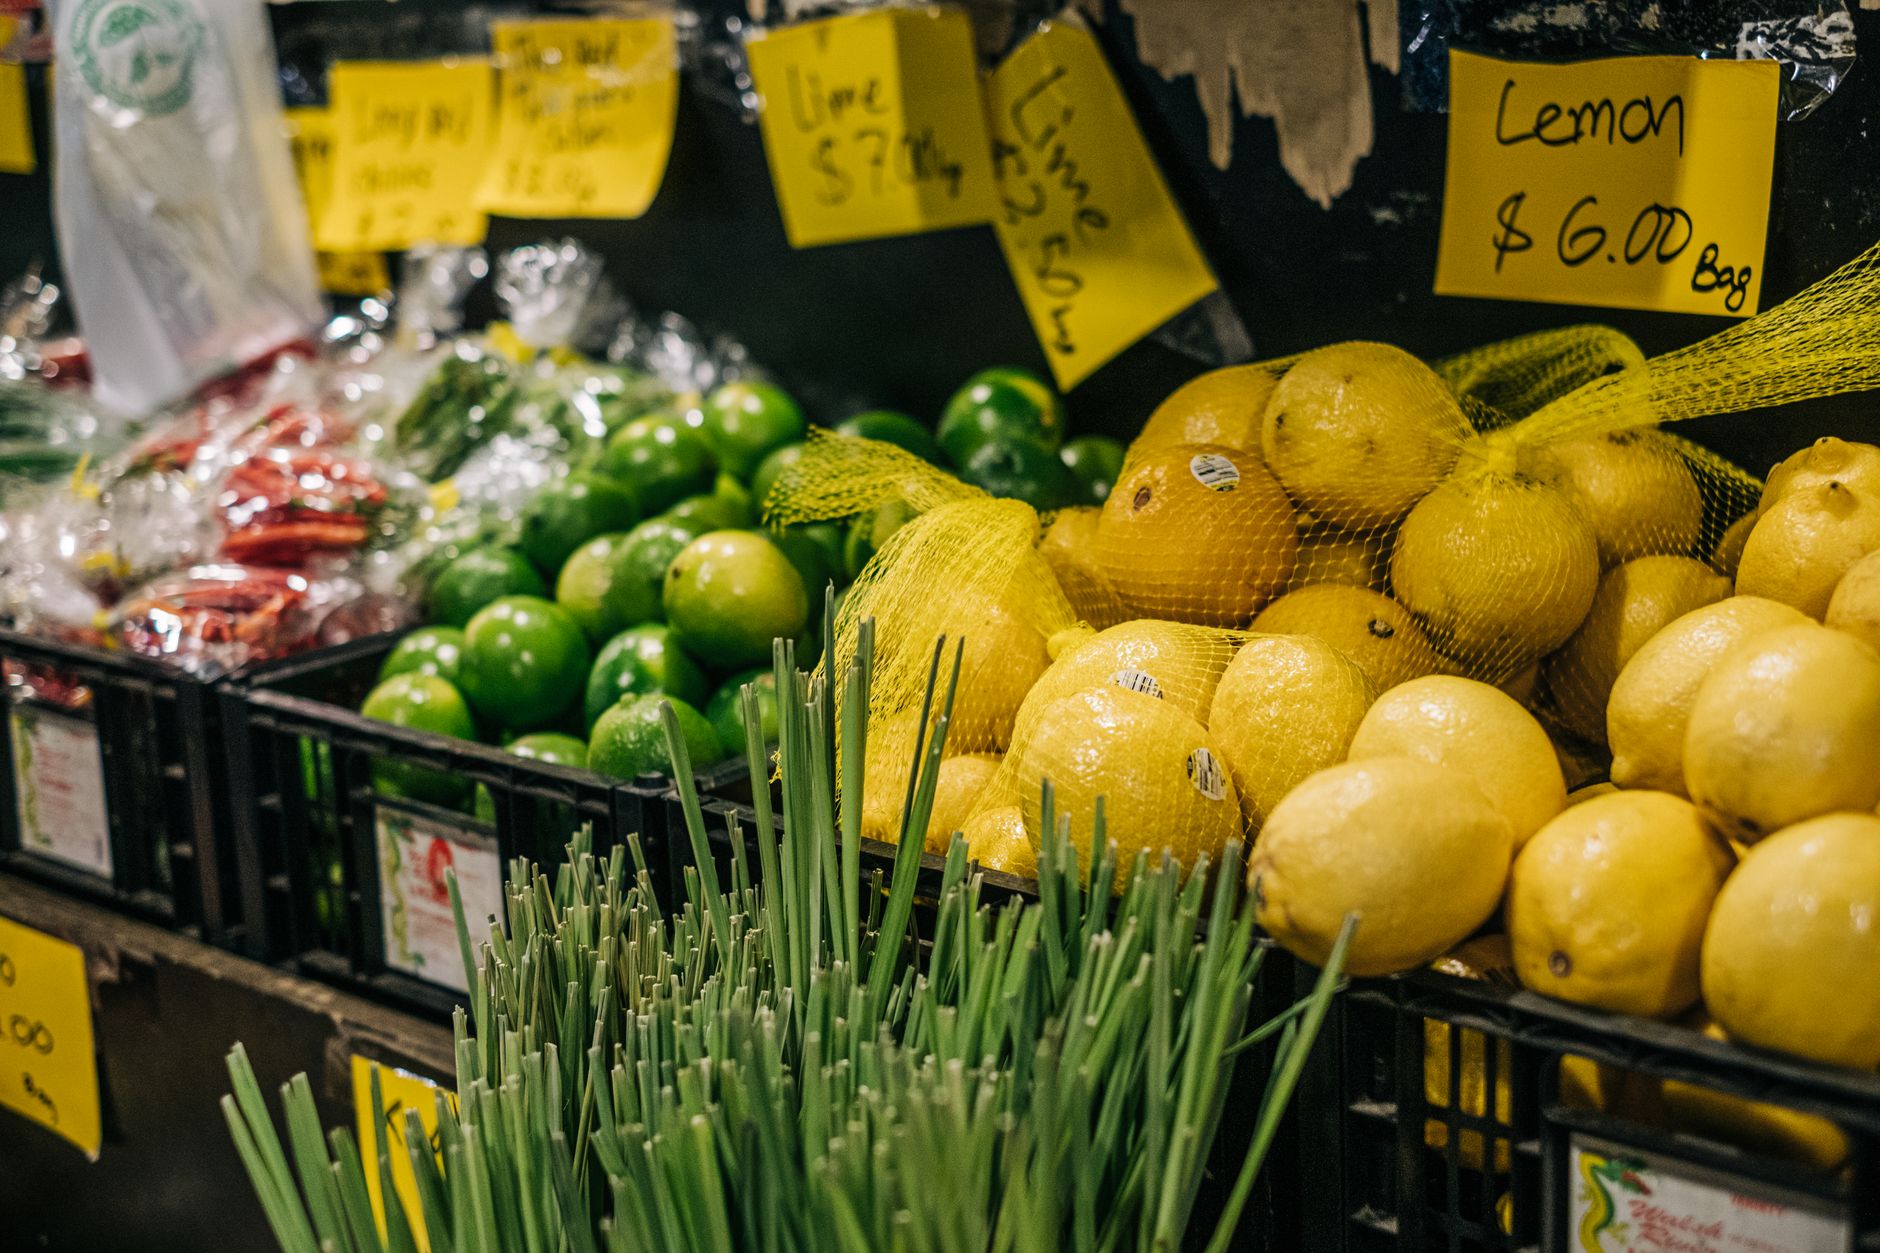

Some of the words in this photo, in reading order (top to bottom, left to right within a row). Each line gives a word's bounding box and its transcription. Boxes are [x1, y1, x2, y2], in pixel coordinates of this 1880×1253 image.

[785, 64, 889, 133] Lime
[1496, 78, 1684, 158] Lemon
[1010, 64, 1110, 247] Lime
[1492, 190, 1534, 274] $
[1557, 194, 1693, 268] 6.00
[1690, 242, 1752, 312] Bag
